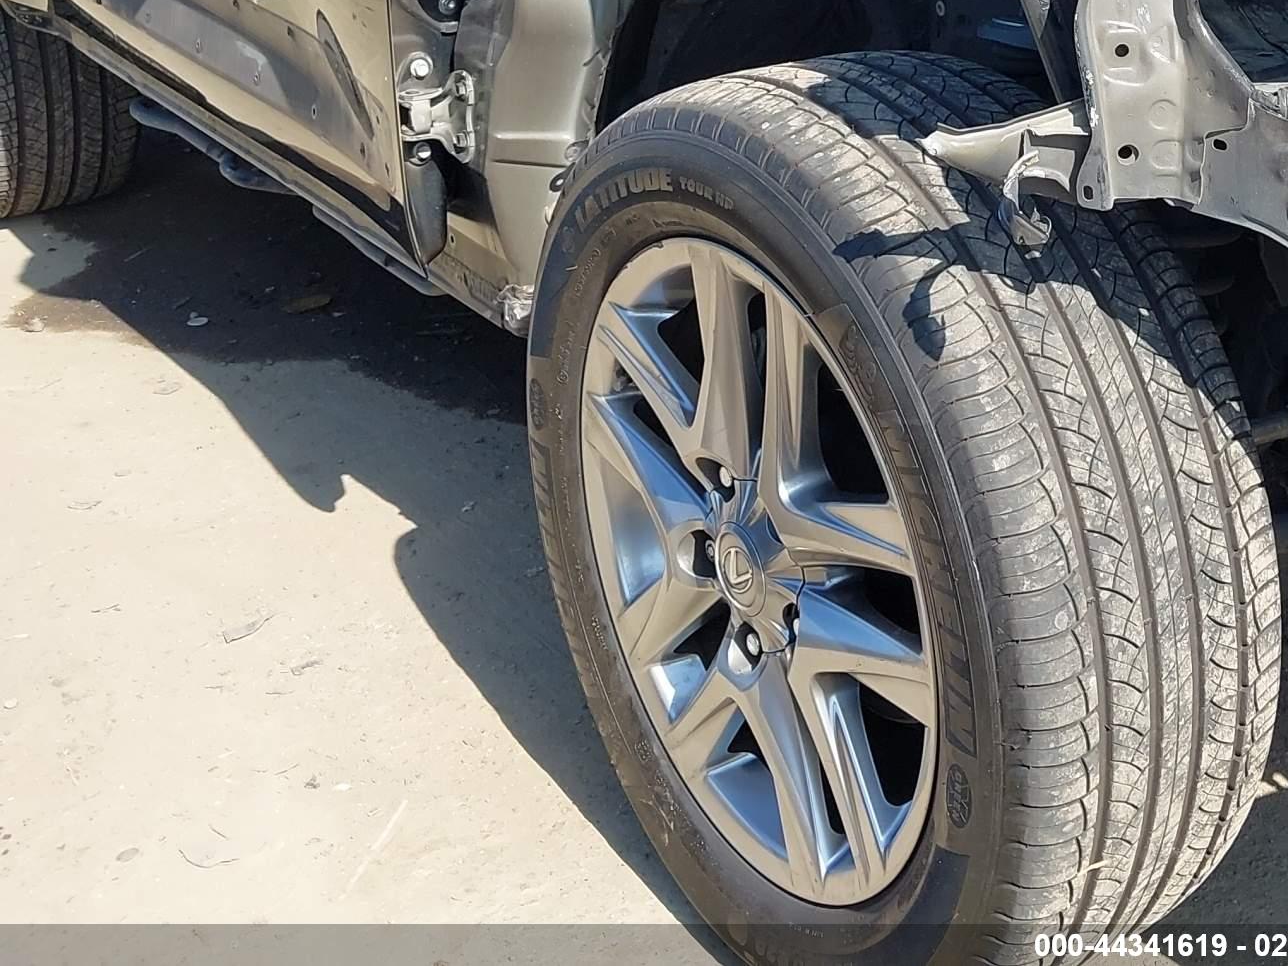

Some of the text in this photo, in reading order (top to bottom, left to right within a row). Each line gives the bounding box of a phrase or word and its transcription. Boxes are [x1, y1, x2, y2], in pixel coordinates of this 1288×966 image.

[574, 168, 673, 233] LATITUDE
[679, 176, 713, 202] TOUR
[875, 407, 976, 753] MICHELIN
